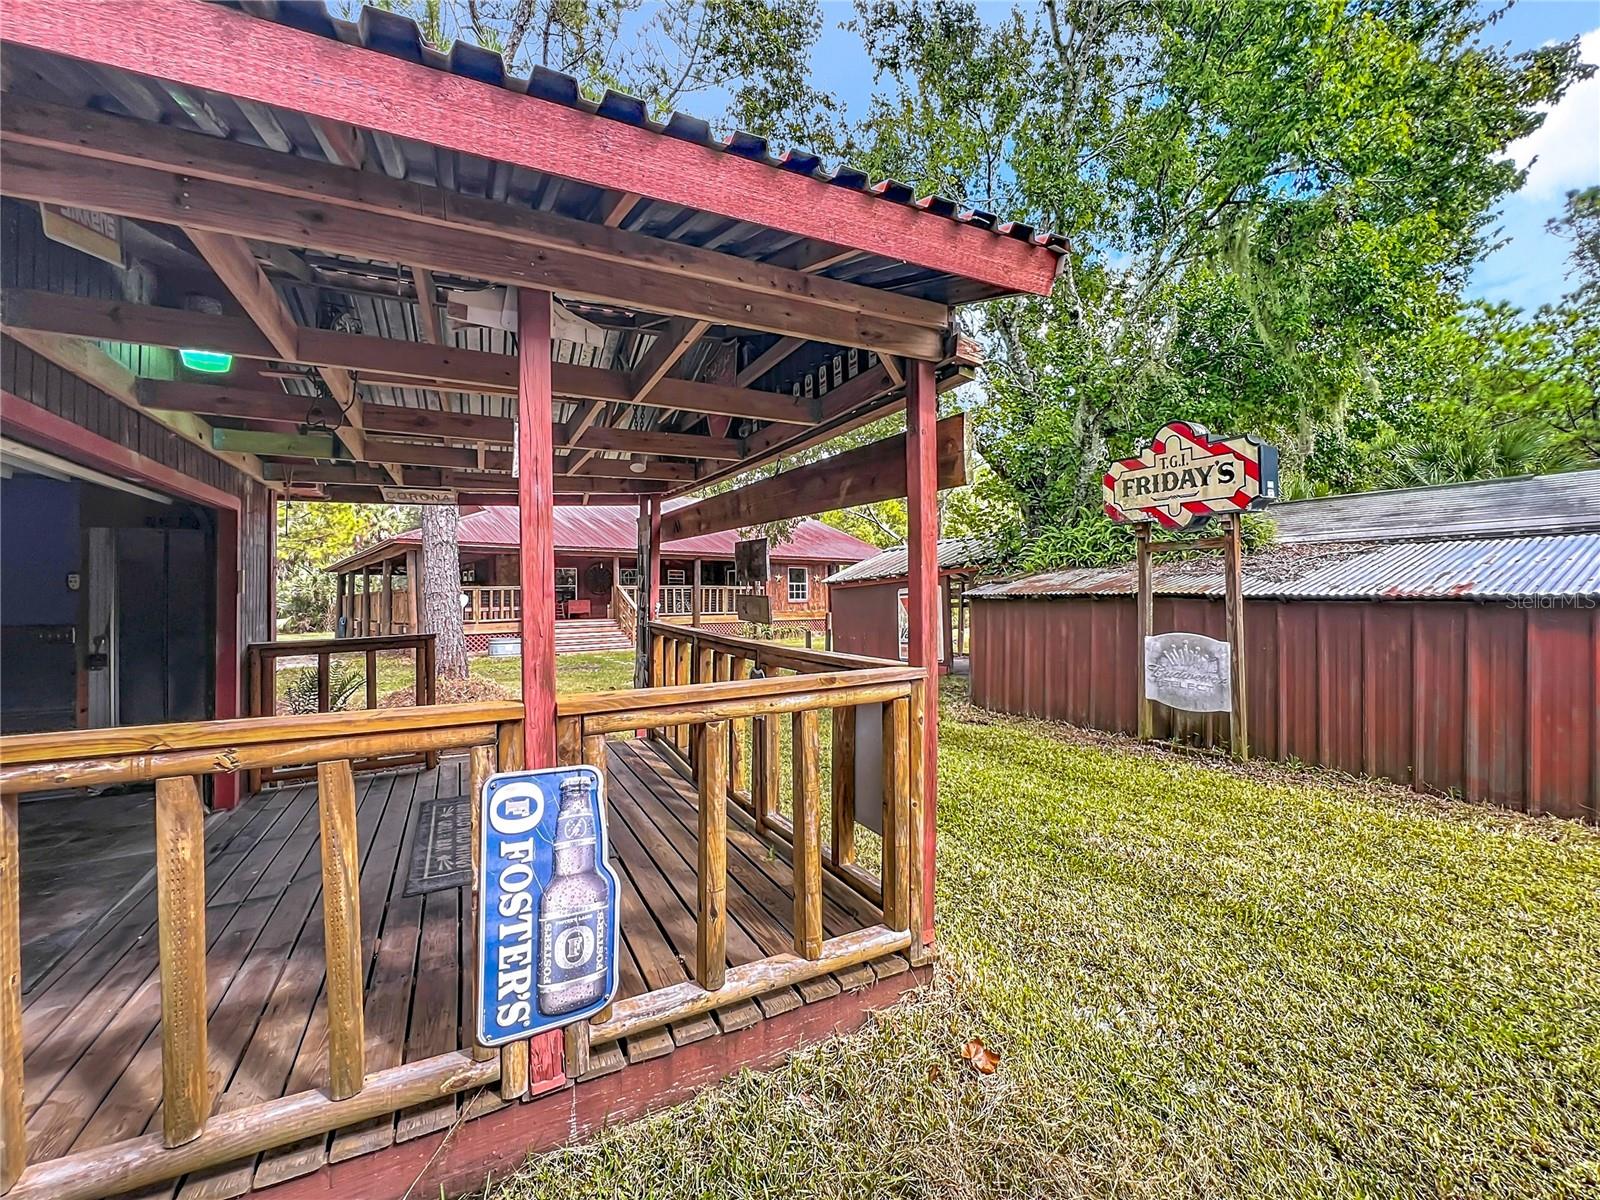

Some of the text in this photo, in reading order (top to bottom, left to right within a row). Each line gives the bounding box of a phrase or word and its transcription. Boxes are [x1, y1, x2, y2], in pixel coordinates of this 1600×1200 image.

[1159, 453, 1189, 470] T.G.I.
[1122, 460, 1235, 498] FRIDAY'S
[386, 491, 449, 501] CORONA
[496, 837, 535, 1027] FOSTER'S
